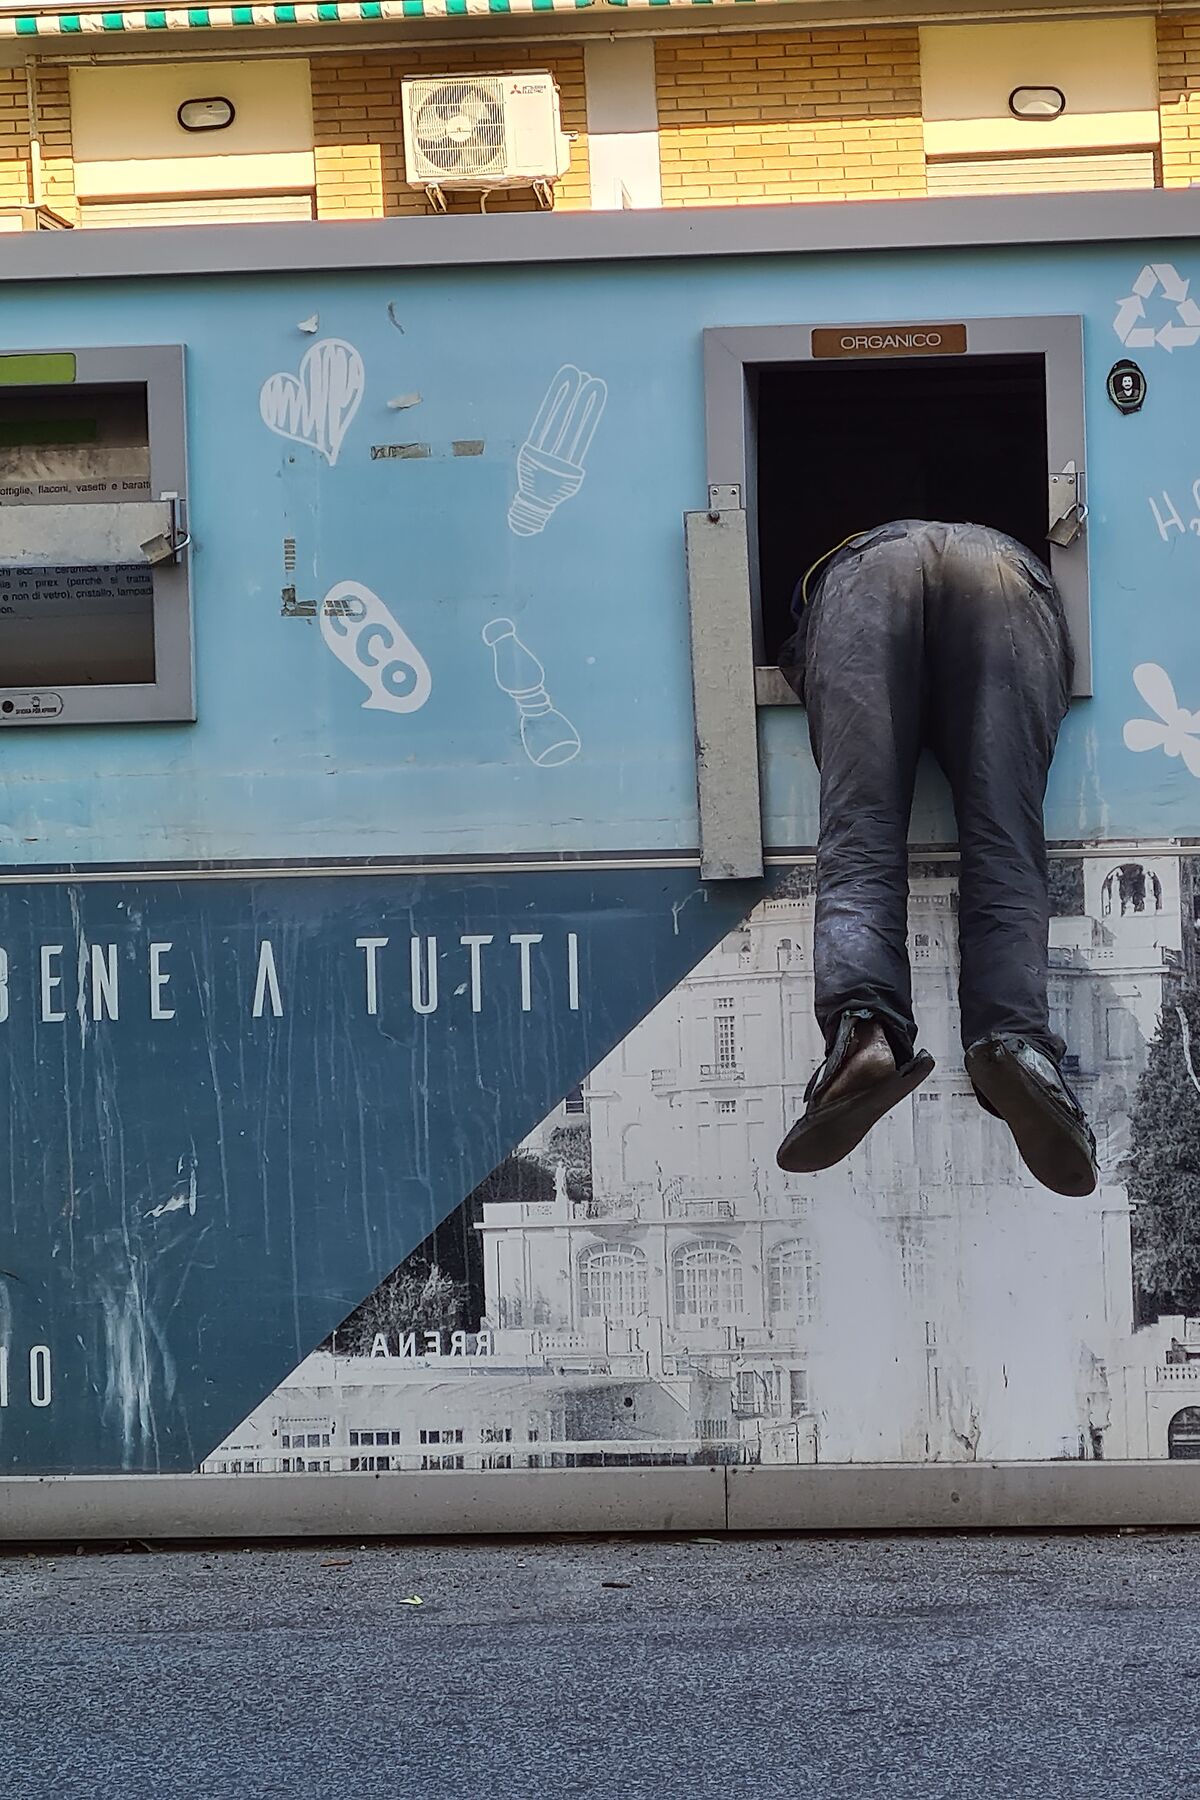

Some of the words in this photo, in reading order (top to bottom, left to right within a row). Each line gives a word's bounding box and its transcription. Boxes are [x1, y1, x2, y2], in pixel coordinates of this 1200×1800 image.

[840, 333, 942, 350] ORGANICO
[252, 940, 283, 1018] A
[355, 932, 579, 1014] TUTTI
